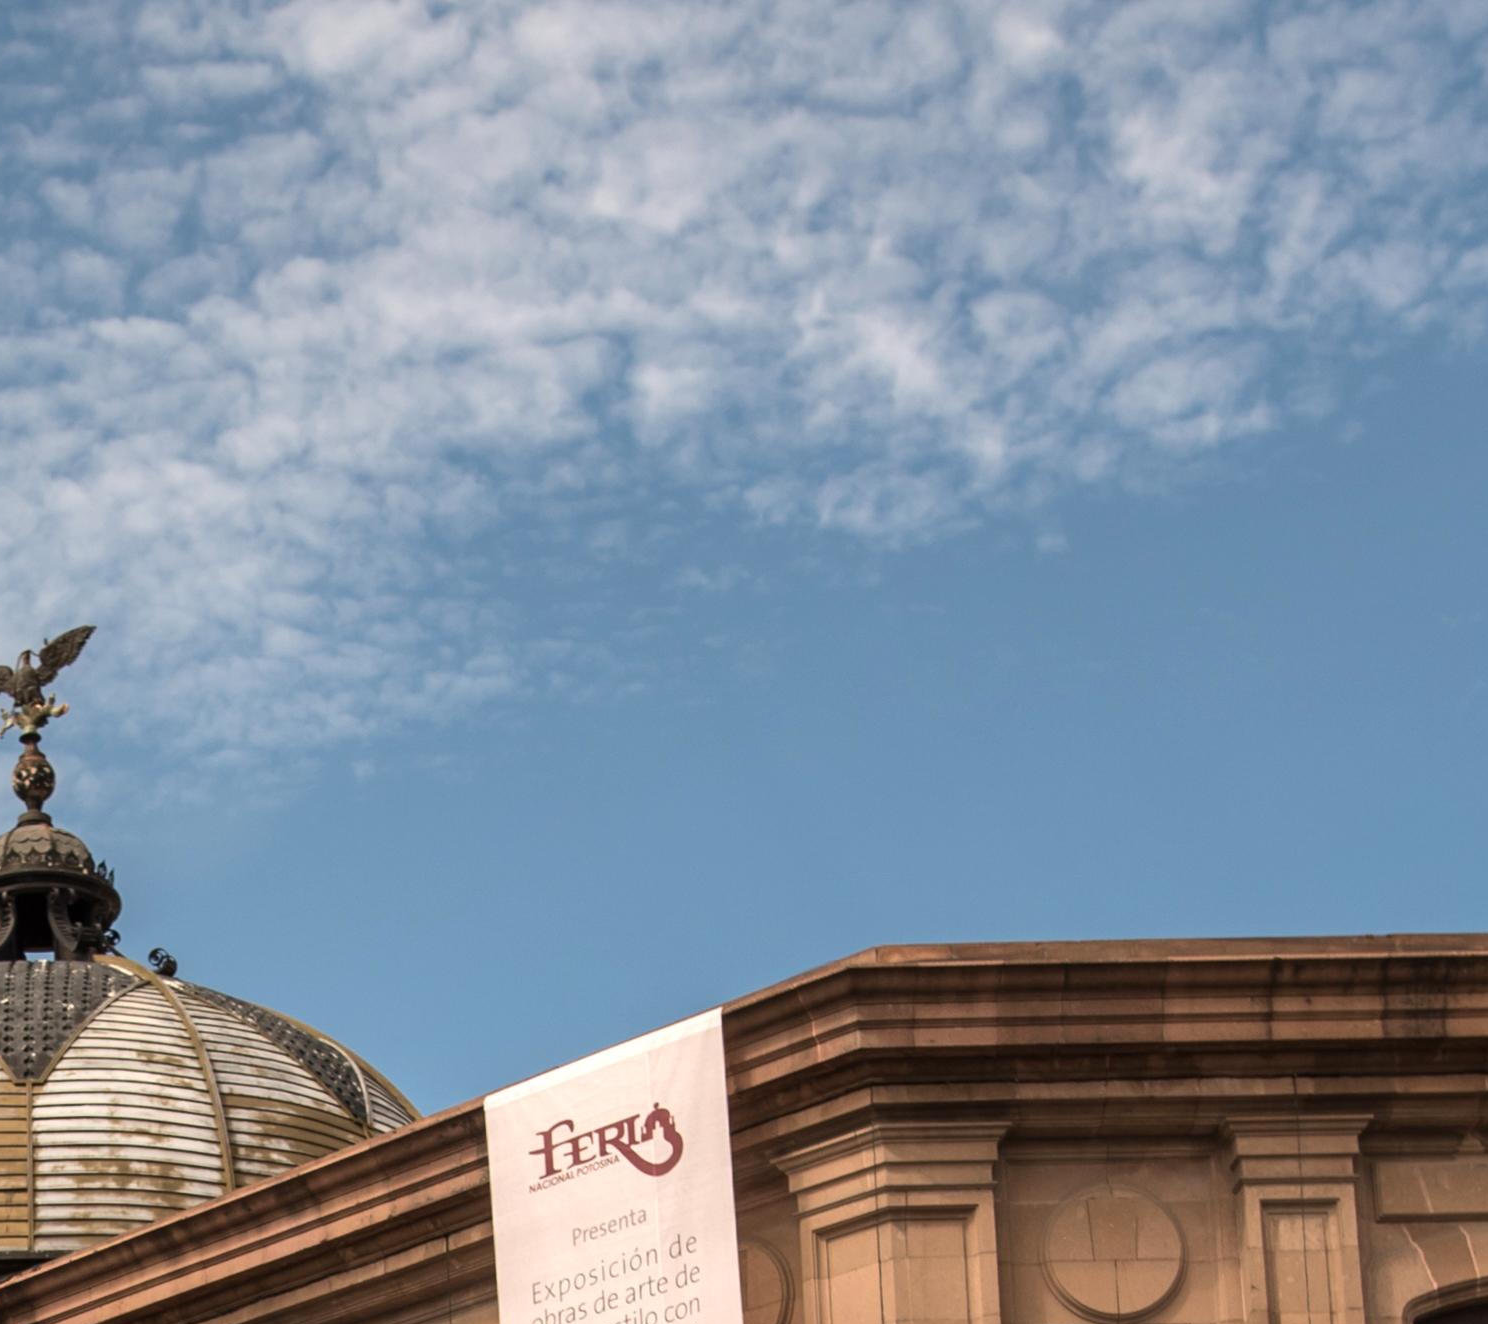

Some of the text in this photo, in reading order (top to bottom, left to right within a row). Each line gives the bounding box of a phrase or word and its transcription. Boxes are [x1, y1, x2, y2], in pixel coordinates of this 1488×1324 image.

[528, 1171, 575, 1194] NACIONAL
[572, 1208, 647, 1246] Presenta
[531, 1233, 698, 1305] Exposición de
[593, 1290, 619, 1315] de
[625, 1275, 669, 1305] arte
[674, 1263, 701, 1289] de
[664, 1297, 701, 1323] con
